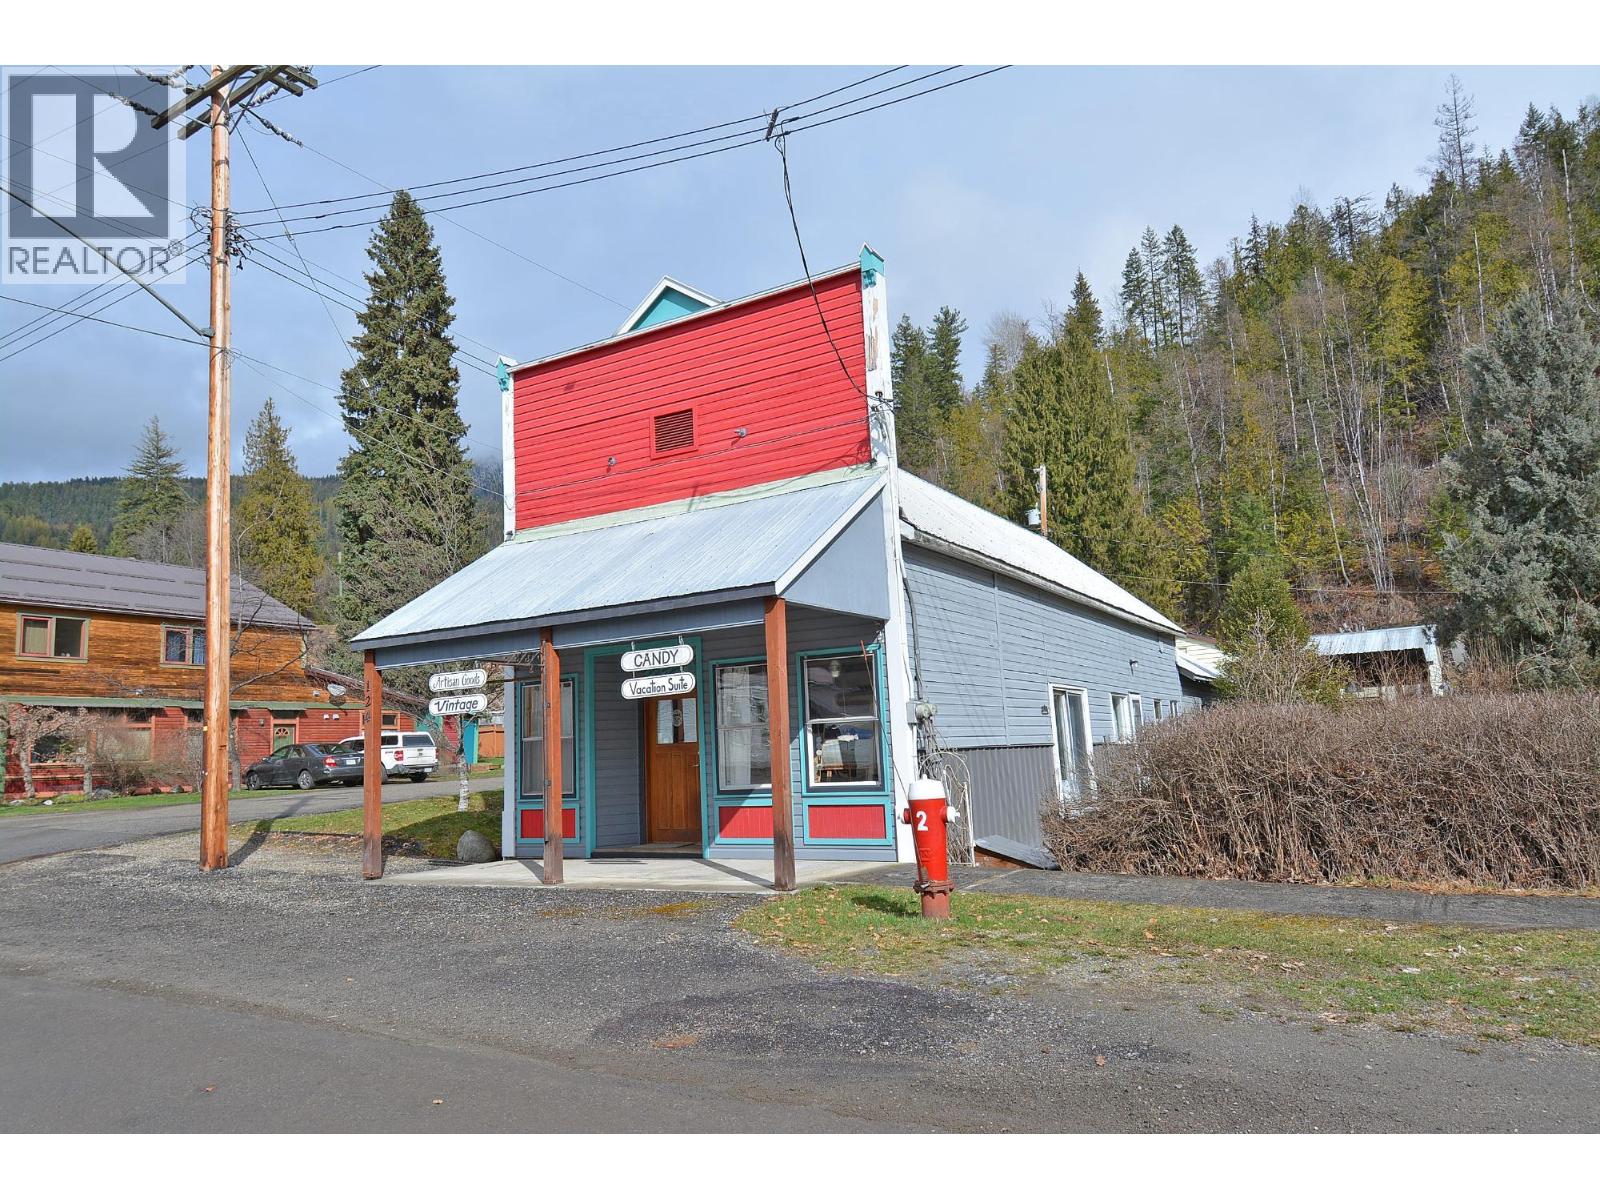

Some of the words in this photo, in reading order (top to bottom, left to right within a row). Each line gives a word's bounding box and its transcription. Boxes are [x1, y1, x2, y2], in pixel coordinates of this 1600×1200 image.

[634, 649, 679, 667] CANDY
[433, 676, 460, 688] Artisan
[461, 673, 480, 686] Goods
[629, 680, 666, 695] Vacation
[668, 676, 688, 691] Suite
[434, 699, 478, 712] Vintage
[916, 811, 928, 831] 2
